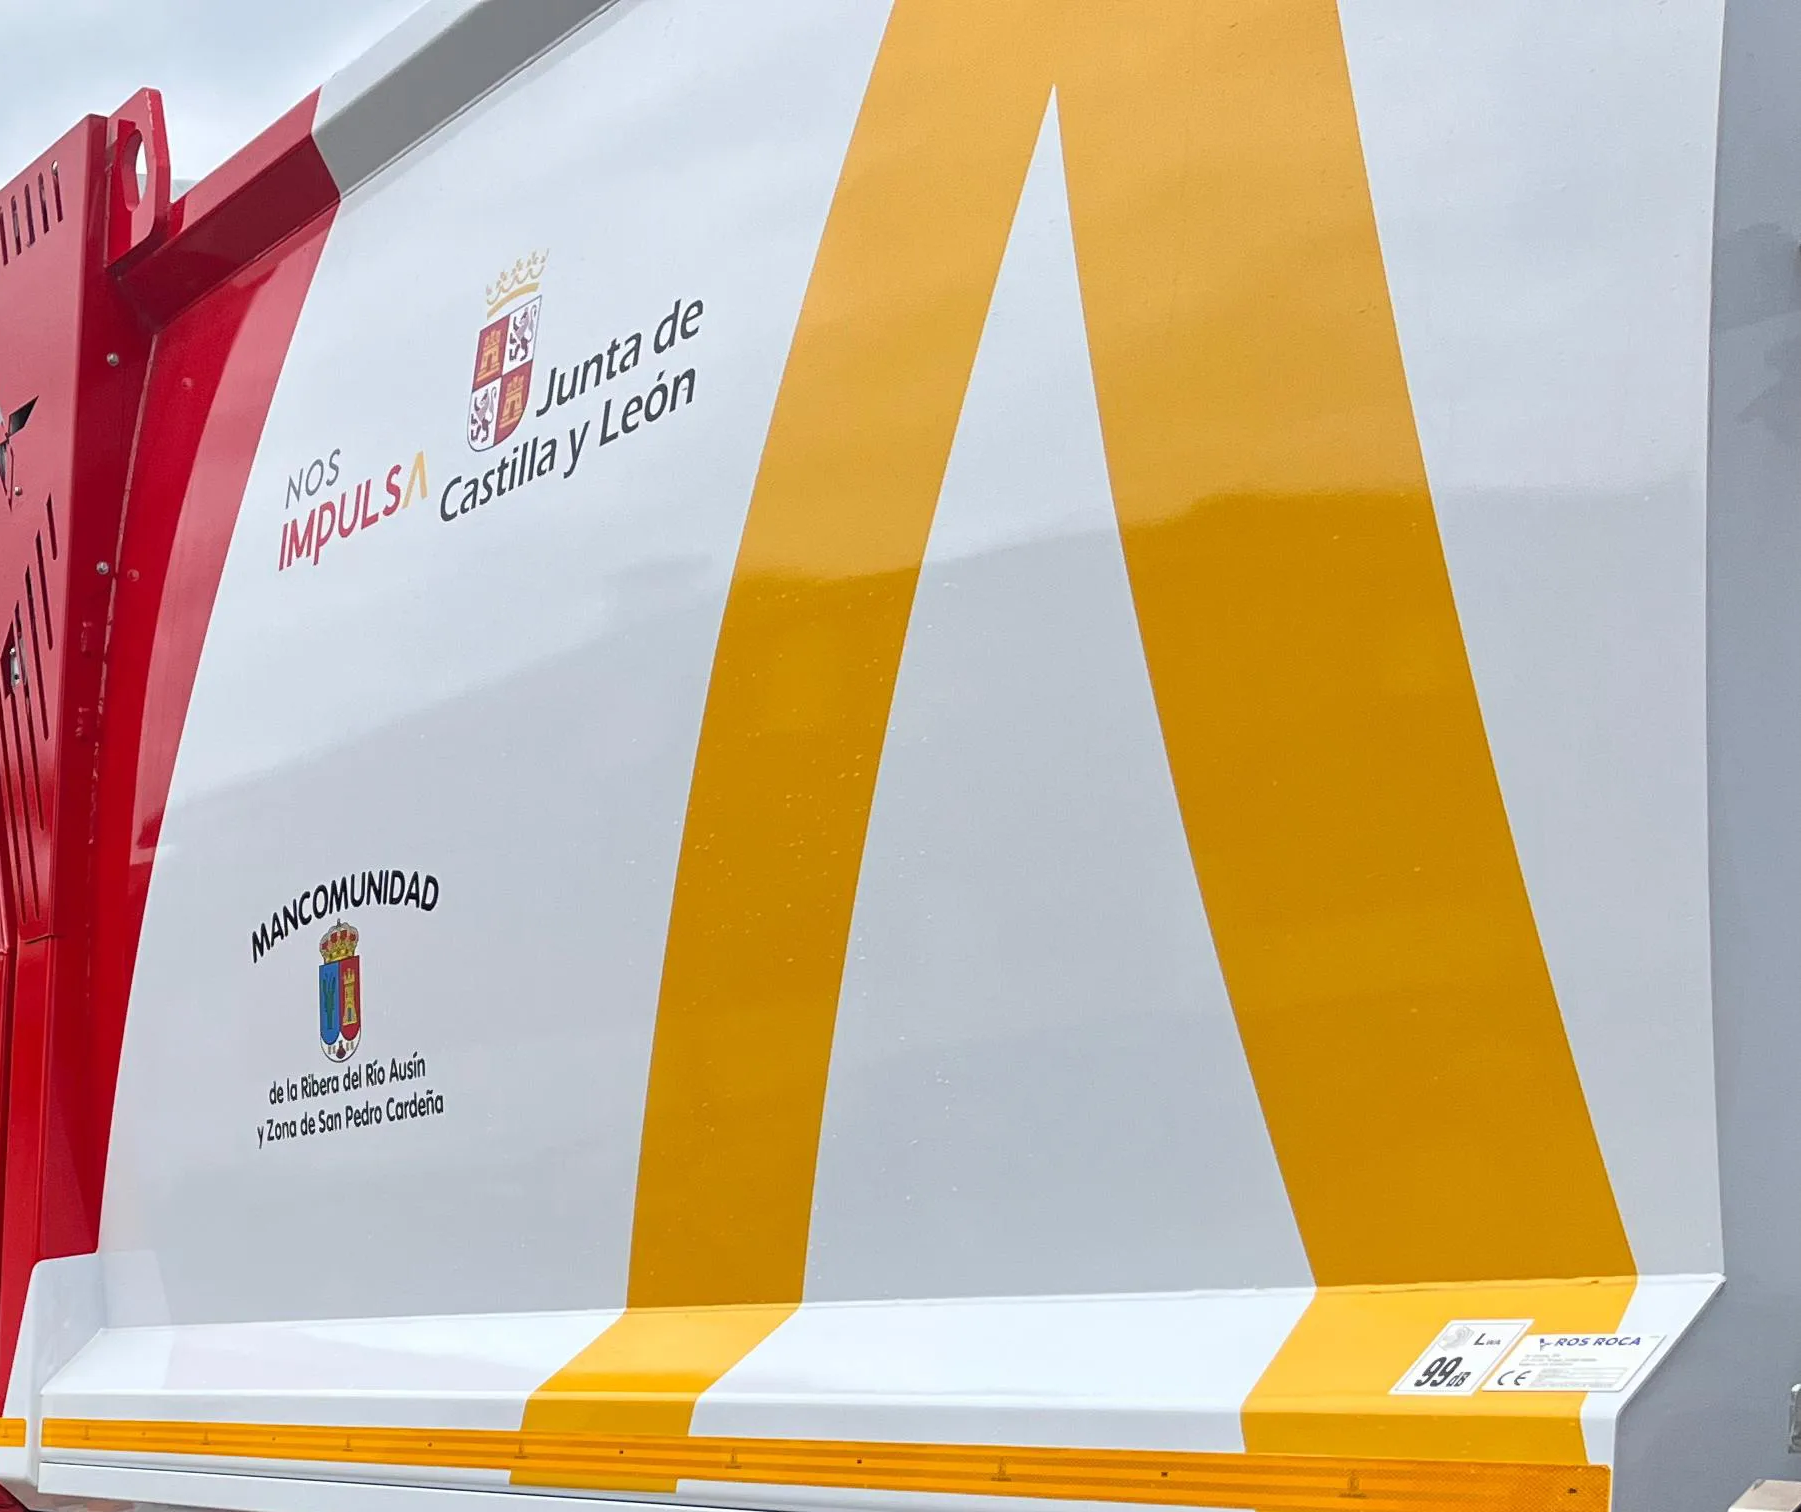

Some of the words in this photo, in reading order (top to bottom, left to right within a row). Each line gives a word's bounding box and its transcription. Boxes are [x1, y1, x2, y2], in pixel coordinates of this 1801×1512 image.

[536, 332, 641, 417] Junta
[653, 298, 704, 354] de
[439, 435, 557, 522] Castilla
[562, 419, 590, 479] y
[599, 367, 696, 447] León
[285, 447, 341, 509] NOS
[251, 869, 439, 963] MANCOMUNIDAD
[269, 1081, 283, 1105] de
[287, 1077, 297, 1102] la
[301, 1073, 339, 1098] Ribera
[343, 1064, 362, 1091] del
[365, 1059, 385, 1086] Río
[389, 1051, 426, 1082] Ausín
[257, 1124, 264, 1149] y
[266, 1118, 297, 1142] Zona
[300, 1112, 316, 1136] de
[318, 1109, 341, 1133] San
[345, 1100, 382, 1129] Pedro
[386, 1089, 444, 1122] Cardeña
[1554, 1337, 1591, 1347] ROS
[1592, 1336, 1641, 1346] ROCA
[1497, 1370, 1532, 1386] CE
